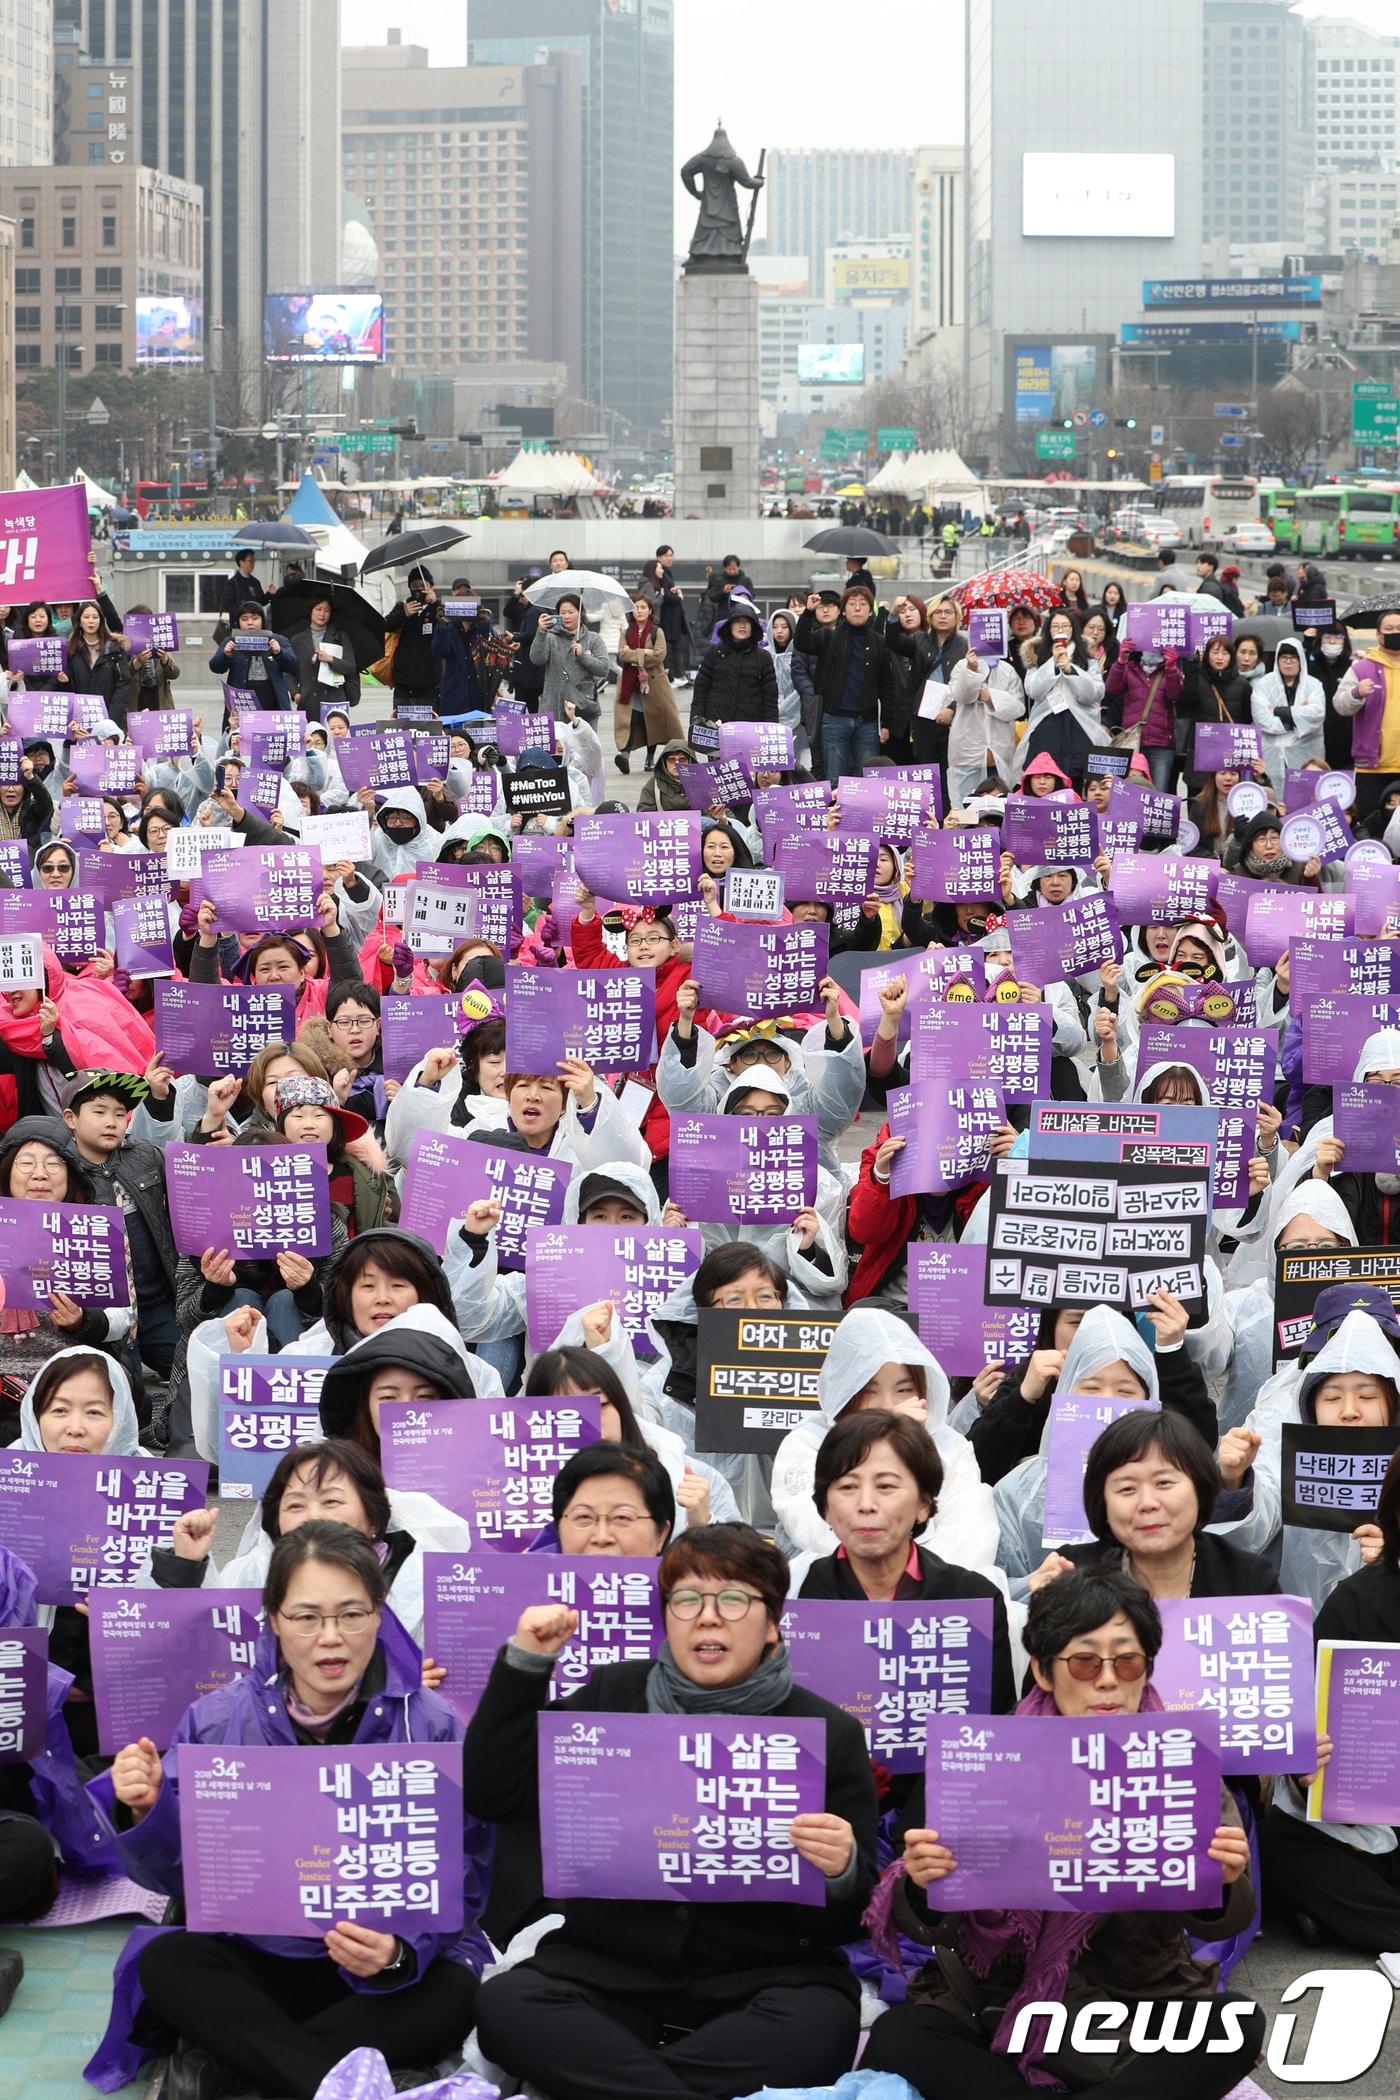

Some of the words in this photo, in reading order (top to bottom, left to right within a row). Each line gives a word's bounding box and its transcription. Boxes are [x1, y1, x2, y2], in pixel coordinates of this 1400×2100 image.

[1163, 284, 1206, 298] 신한은행
[4, 515, 36, 529] 녹색당
[41, 695, 49, 704] 내
[52, 695, 69, 704] 삶을
[43, 715, 67, 724] 성평등
[44, 706, 68, 714] 바꾸는
[34, 724, 67, 734] 민주주의
[510, 778, 556, 792] #MeToo
[512, 792, 565, 805] #WithYou
[260, 853, 275, 868] 내
[281, 852, 311, 867] 삶을
[269, 870, 312, 884] 바꾸는
[269, 886, 313, 903] 성평등
[255, 903, 314, 921] 민주주의
[463, 994, 489, 1015] #with
[948, 990, 972, 1002] #me
[1001, 990, 1017, 1000] too
[1153, 1004, 1177, 1017] #me
[1208, 1002, 1228, 1011] too
[1209, 1038, 1226, 1056] 내
[1233, 1037, 1266, 1056] 삶을
[1216, 1058, 1264, 1077] 바꾸는
[1042, 1114, 1156, 1135] #내삶을_바꾸는
[740, 1127, 757, 1147] 내
[767, 1125, 805, 1146] 삶을
[749, 1149, 804, 1169] 바꾸는
[1123, 1146, 1207, 1164] _성폭력근절
[242, 1157, 262, 1178] 내
[271, 1154, 313, 1176] 삶을
[254, 1179, 314, 1201] 바꾸는
[747, 1171, 805, 1191] 성평등
[729, 1192, 804, 1214] 민주주의
[1124, 1187, 1201, 1214] 성스러운
[252, 1202, 316, 1226] 성평등
[233, 1227, 317, 1249] 민주주의
[1001, 1222, 1097, 1251] 임신중절은
[1112, 1229, 1184, 1252] 있었다면
[996, 1265, 1016, 1287] 수
[1028, 1273, 1048, 1297] 할
[1064, 1270, 1120, 1294] 임신을
[742, 1324, 787, 1349] 여자
[223, 1369, 253, 1402] 내
[489, 1411, 515, 1440] 내
[526, 1409, 582, 1439] 삶을
[504, 1443, 580, 1472] 바꾸는
[1300, 1456, 1355, 1476] 낙태가
[487, 1478, 500, 1486] For
[472, 1488, 501, 1497] Gender
[1299, 1484, 1354, 1505] 범인은
[475, 1499, 501, 1509] Justice
[864, 1618, 892, 1650] 내
[907, 1615, 971, 1648] 삶을
[1184, 1616, 1212, 1647] 내
[1226, 1611, 1291, 1645] 삶을
[879, 1654, 970, 1686] 바꾸는
[1201, 1650, 1292, 1681] 바꾸는
[874, 1689, 969, 1724] 성평등
[1197, 1687, 1294, 1719] 성평등
[568, 1747, 603, 1757] 세계여성의
[606, 1747, 614, 1757] 날
[616, 1748, 631, 1756] 기념
[679, 1733, 712, 1770] 내
[727, 1733, 800, 1770] 삶을
[955, 1752, 993, 1762] 세계여성의
[995, 1752, 1003, 1762] 날
[1005, 1752, 1021, 1762] 기념
[1071, 1732, 1105, 1771] 내
[1121, 1728, 1196, 1768] 삶을
[555, 1756, 598, 1766] 한국여성대회
[941, 1762, 986, 1772] 한국여성대회
[208, 1781, 245, 1791] 세계여성의
[247, 1781, 254, 1791] 날
[256, 1782, 271, 1791] 기념
[319, 1763, 352, 1799] 내
[367, 1759, 439, 1798] 삶을
[195, 1790, 238, 1800] 한국여성대회
[696, 1776, 800, 1812] 바꾸는
[1090, 1774, 1196, 1812] 바꾸는
[337, 1801, 439, 1839] 바꾸는
[672, 1815, 689, 1825] For
[1064, 1819, 1083, 1829] For
[653, 1827, 689, 1837] Gender
[692, 1815, 795, 1850] 성평등
[1045, 1833, 1083, 1844] Gender
[1085, 1815, 1197, 1854] 성평등
[313, 1846, 331, 1856] For
[657, 1840, 690, 1850] Justice
[1048, 1845, 1083, 1856] Justice
[295, 1859, 331, 1869] Gender
[333, 1840, 440, 1880] 성평등
[658, 1852, 800, 1885] 민주주의
[298, 1871, 332, 1882] Justice
[1049, 1856, 1196, 1892] 민주주의
[299, 1879, 440, 1920] 민주주의
